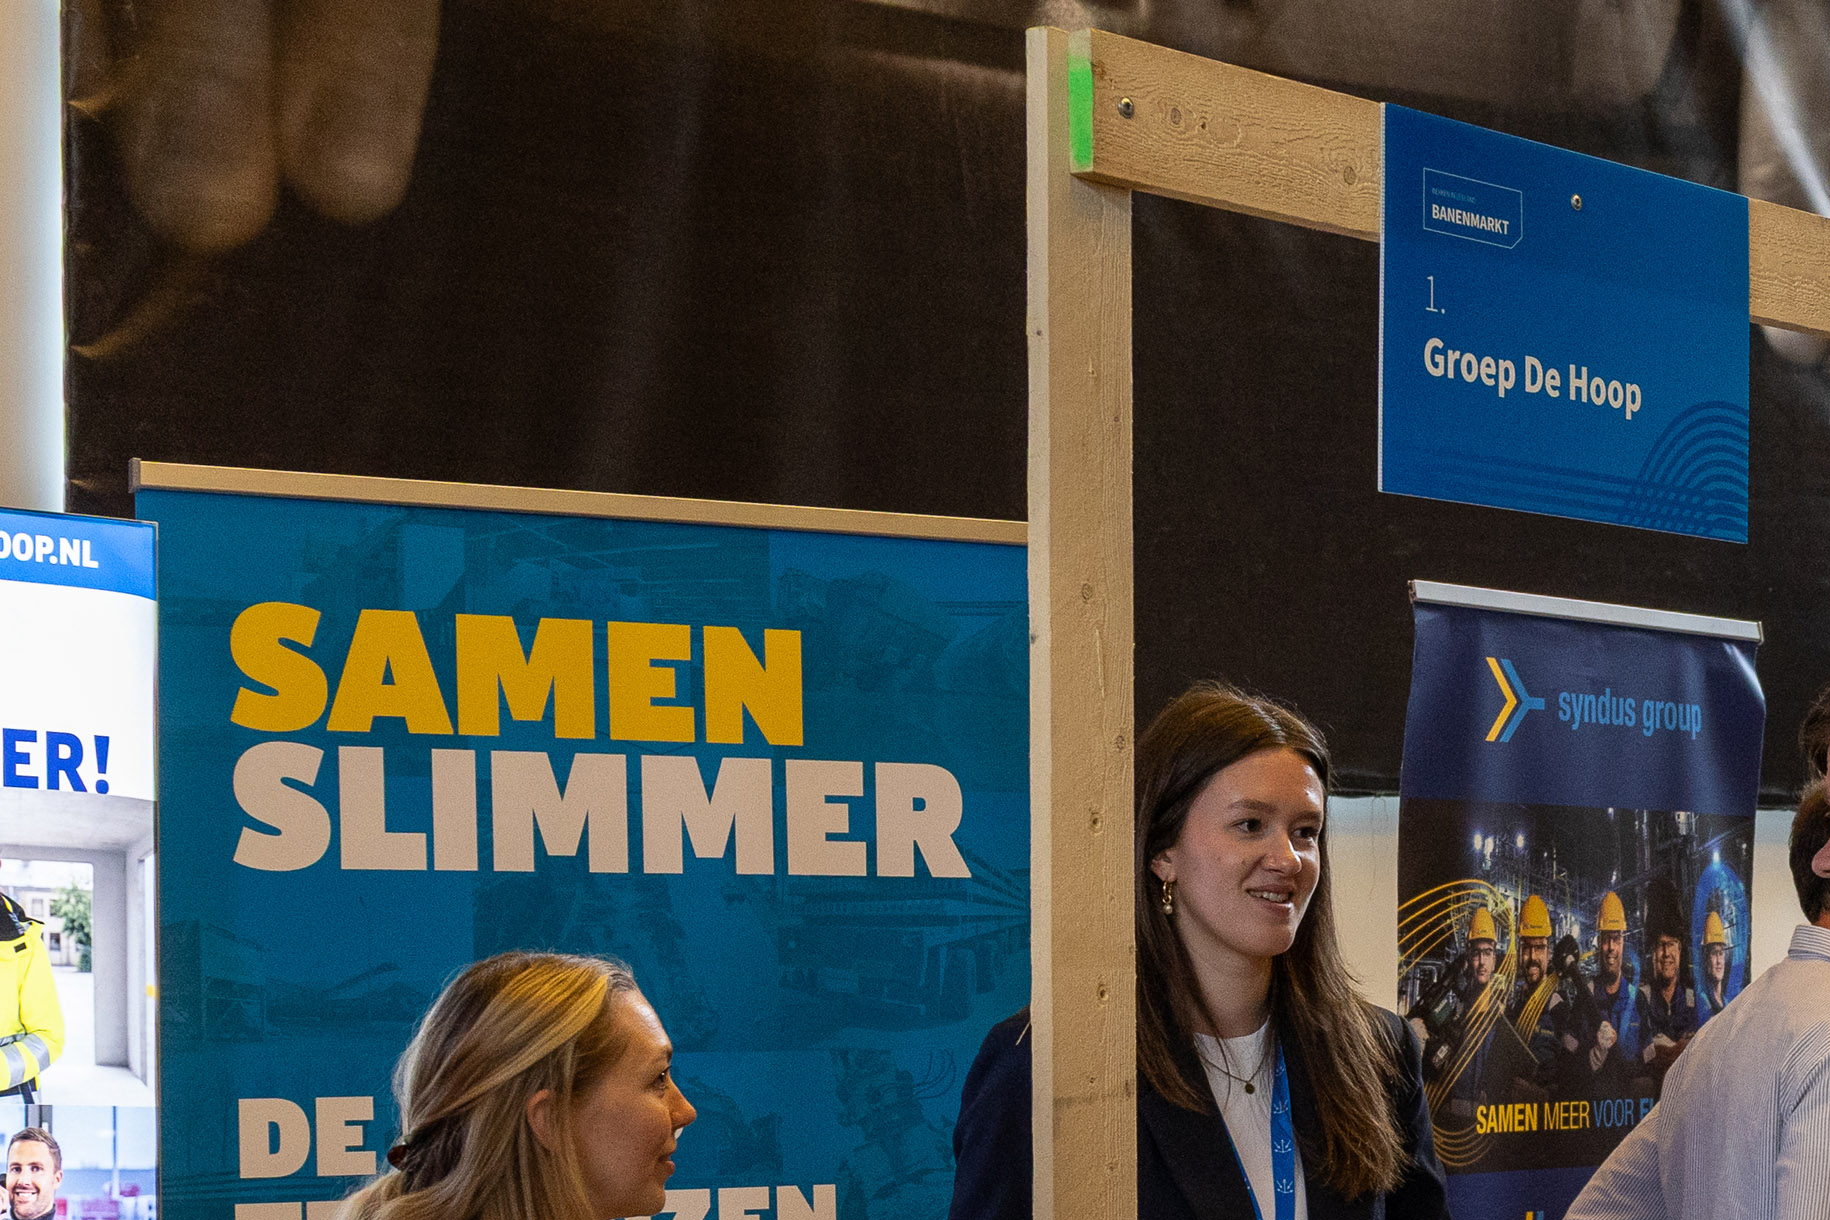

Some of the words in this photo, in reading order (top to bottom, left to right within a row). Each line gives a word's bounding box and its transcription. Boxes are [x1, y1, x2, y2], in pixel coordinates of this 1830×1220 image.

[1432, 204, 1509, 235] BANENMARKT
[1425, 276, 1446, 314] 1.
[1424, 337, 1516, 397] Groep
[1524, 356, 1561, 398] De
[1569, 364, 1642, 420] Hoop
[230, 601, 804, 746] SAMEN
[1558, 688, 1637, 729] syndus
[1642, 697, 1702, 738] group
[233, 741, 972, 878] SLIMMER
[1476, 1101, 1538, 1136] SAMEN
[1543, 1099, 1590, 1131] MEER
[1593, 1098, 1635, 1128] VOOR
